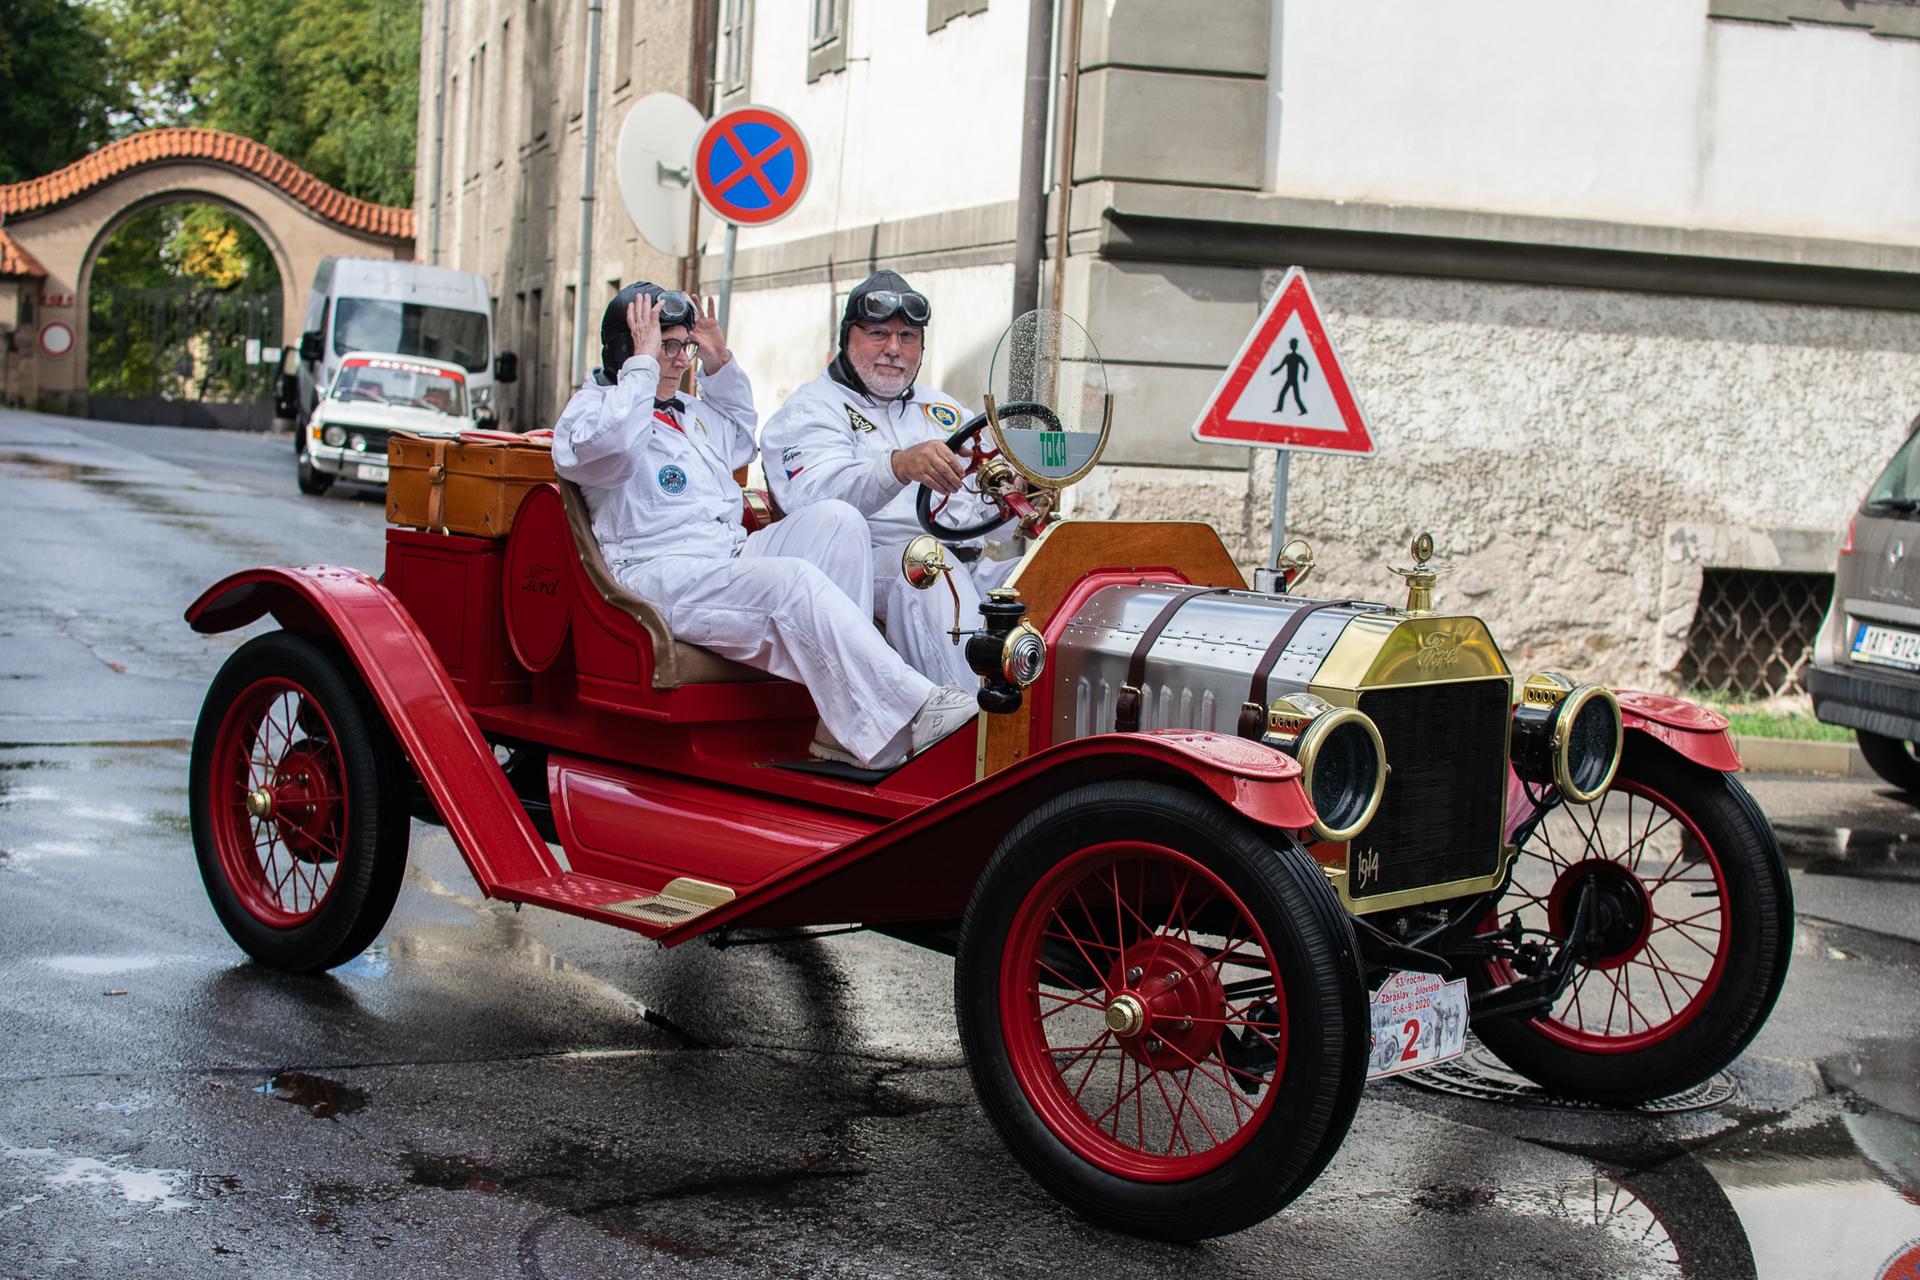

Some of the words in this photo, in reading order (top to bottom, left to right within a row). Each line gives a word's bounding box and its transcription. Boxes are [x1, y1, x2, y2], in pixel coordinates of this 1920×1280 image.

[1039, 432, 1067, 467] TOKA
[1358, 847, 1379, 889] 1914
[1381, 991, 1409, 1004] Zbraslav
[1415, 998, 1431, 1010] 2020
[1401, 1019, 1420, 1061] 2
